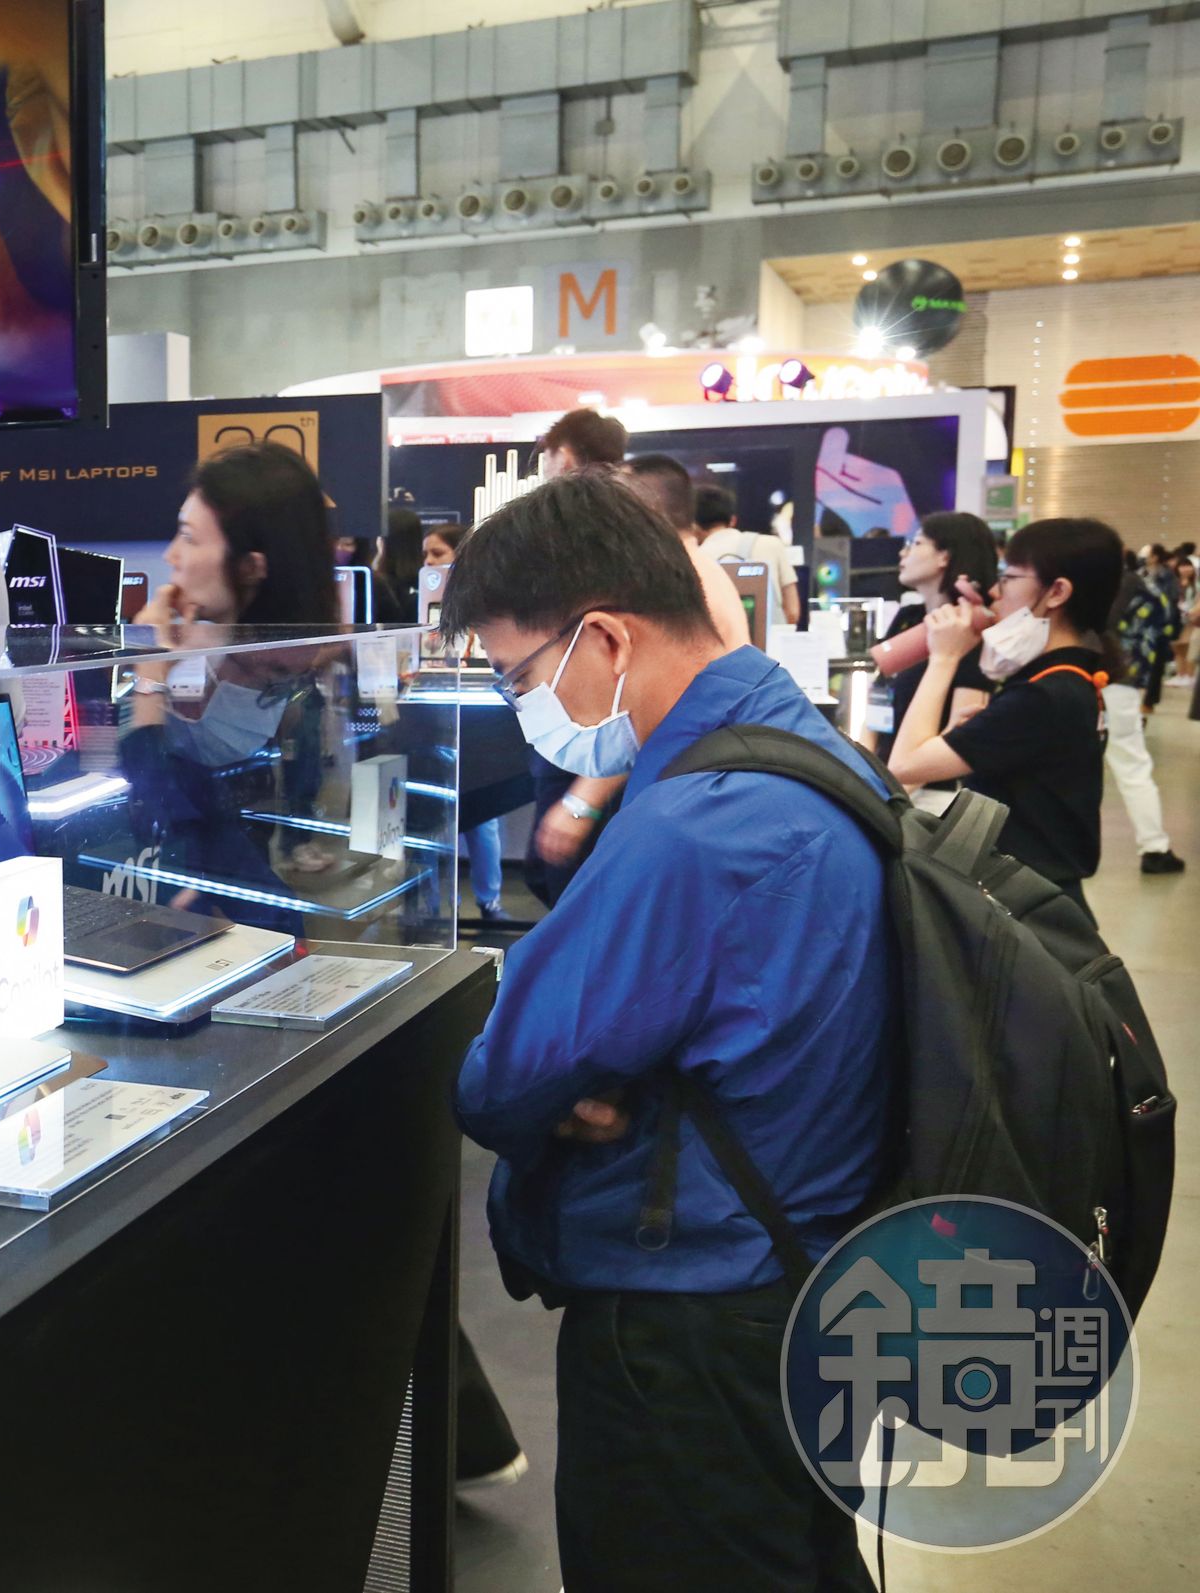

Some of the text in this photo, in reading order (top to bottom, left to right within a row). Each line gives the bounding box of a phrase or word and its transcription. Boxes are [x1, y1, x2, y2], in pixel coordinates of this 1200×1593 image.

[559, 270, 617, 337] M
[65, 466, 158, 480] LAPTOPS
[9, 576, 47, 588] msi
